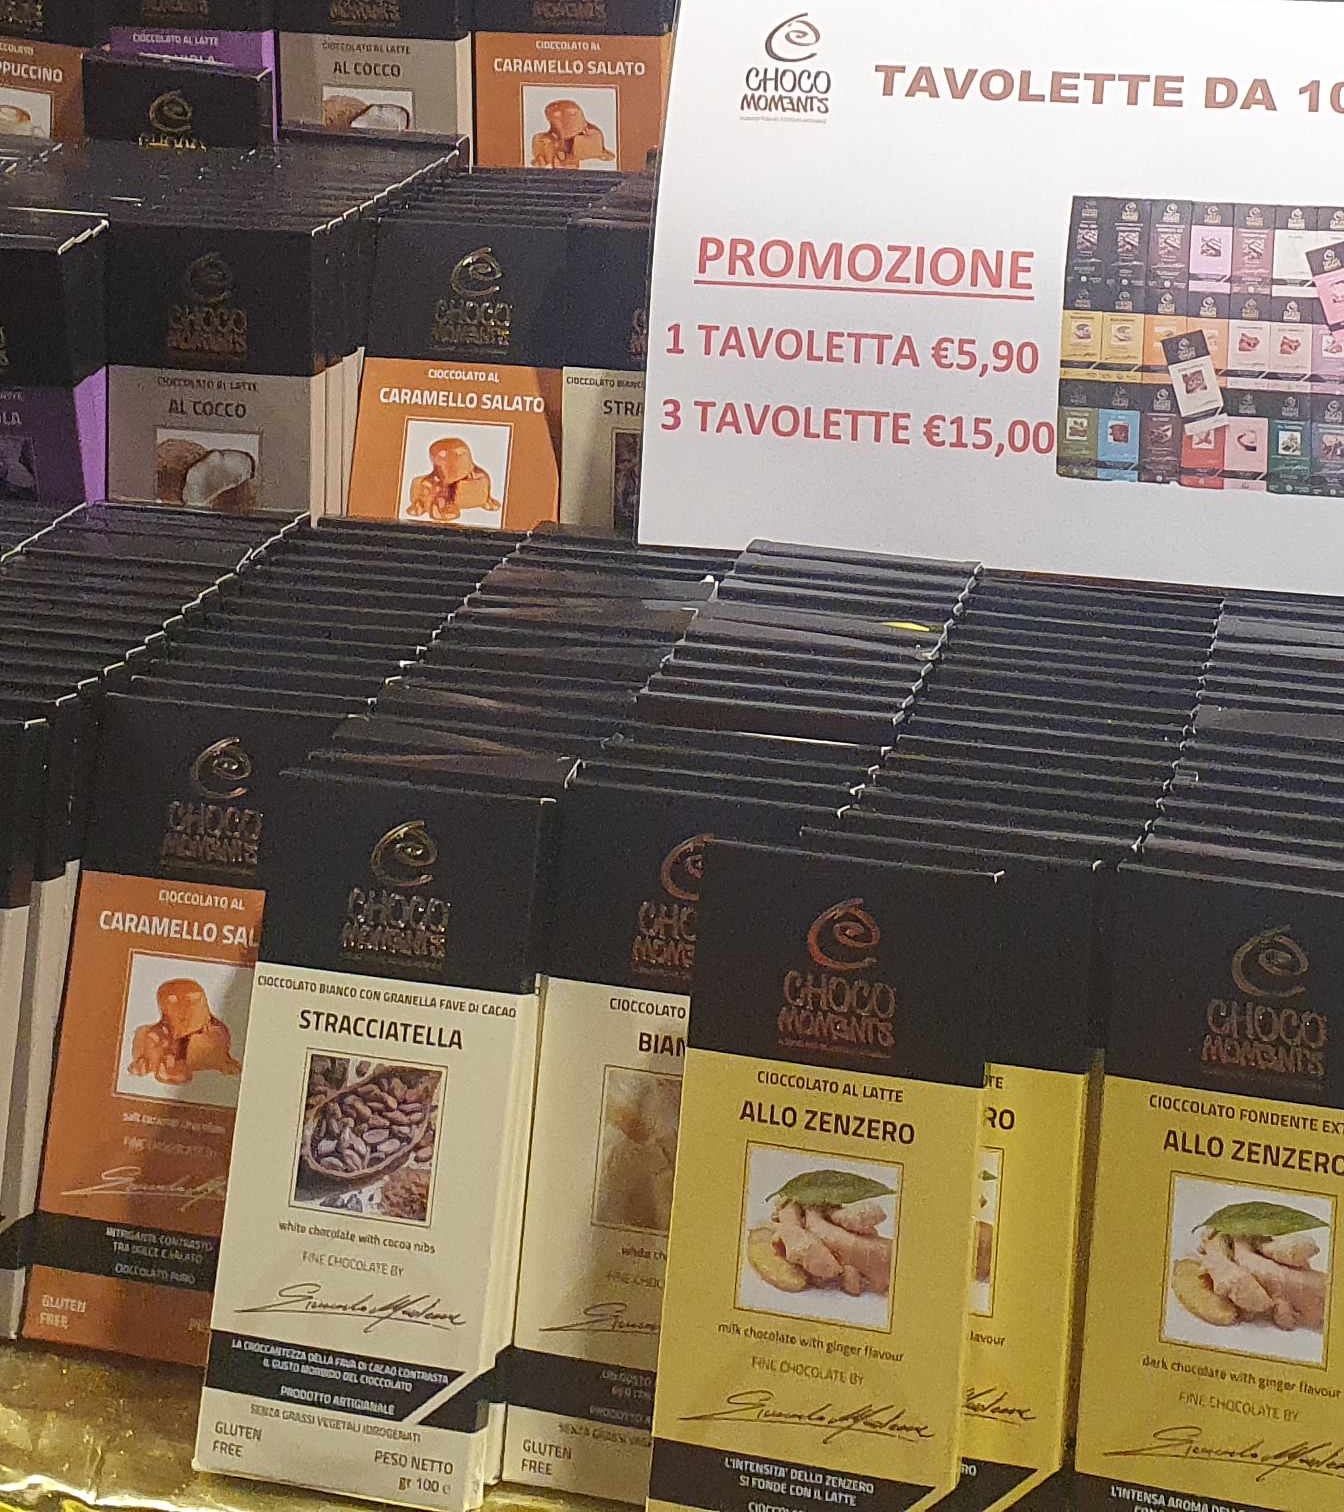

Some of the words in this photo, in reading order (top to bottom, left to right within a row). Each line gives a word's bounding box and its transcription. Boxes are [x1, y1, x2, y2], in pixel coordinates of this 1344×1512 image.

[494, 58, 583, 75] CARAMELLO
[587, 59, 645, 76] SALATO
[746, 68, 831, 95] CHOCO
[875, 63, 1185, 109] TAVOLETTE
[1204, 77, 1279, 110] DA
[697, 236, 1034, 291] PROMOZIONE
[665, 325, 685, 355] 1
[697, 326, 919, 368] TAVOLETTA
[931, 337, 1039, 376] €5,90
[428, 369, 483, 382] CIOCCOLATO
[486, 371, 499, 383] AL
[380, 388, 478, 409] CARAMELLO
[482, 394, 545, 414] SALATO
[662, 400, 681, 431] 3
[694, 401, 912, 445] TAVOLETTE
[923, 415, 1056, 456] €15,00
[159, 890, 228, 909] CIOCCOLATO
[231, 898, 244, 910] AL
[100, 909, 217, 943] CARAMELLO
[258, 975, 317, 994] CIOCCOLATO
[319, 982, 357, 998] BIANCO
[360, 987, 381, 1001] CON
[383, 990, 436, 1007] GRANELLA
[439, 997, 465, 1012] FAVE
[468, 1001, 479, 1012] DI
[482, 1004, 516, 1019] CACAO
[783, 969, 897, 1018] CHOCO
[299, 1009, 463, 1049] STRACCIATELLA
[758, 1069, 839, 1094] CIOCCOLATO
[843, 1082, 859, 1097] AL
[863, 1085, 903, 1103] LATTE
[741, 1100, 796, 1128] ALLO
[804, 1109, 914, 1146] ZENZERO
[1149, 1094, 1235, 1120] CIOCCOLATO
[1240, 1108, 1318, 1132] FONDENTE
[1163, 1129, 1223, 1158] ALLO
[279, 1221, 306, 1234] white
[308, 1225, 355, 1243] chocolate
[358, 1233, 380, 1246] with
[382, 1238, 411, 1250] cocoa
[414, 1241, 435, 1254] nibs
[718, 1323, 741, 1337] milk
[744, 1325, 796, 1346] chocolate
[800, 1334, 823, 1348] with
[827, 1339, 862, 1358] ginger
[864, 1344, 904, 1362] flavour
[215, 1421, 262, 1441] GLUTEN
[213, 1441, 243, 1457] FREE
[374, 1450, 407, 1468] PESO
[411, 1457, 453, 1474] NETTO
